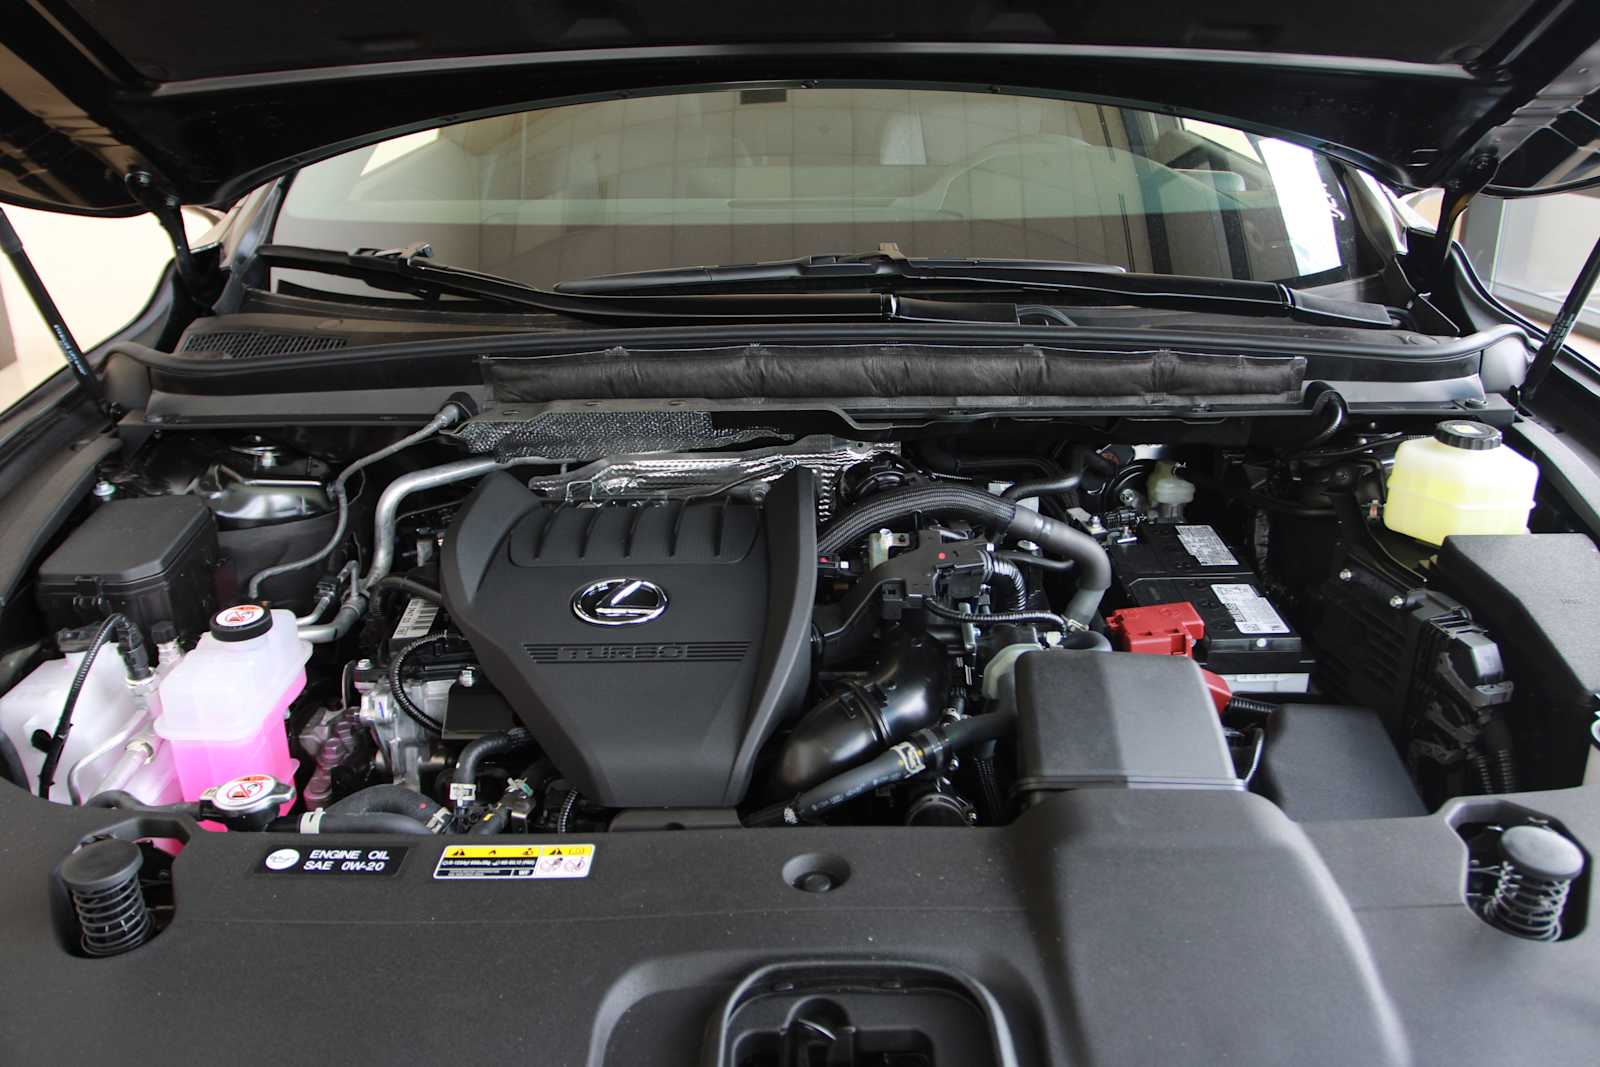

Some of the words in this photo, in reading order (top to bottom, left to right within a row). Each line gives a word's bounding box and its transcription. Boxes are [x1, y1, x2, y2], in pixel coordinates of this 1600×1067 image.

[558, 645, 685, 660] TURBO
[309, 849, 361, 860] ENGINE
[367, 850, 390, 861] OIL
[303, 861, 334, 871] SAE
